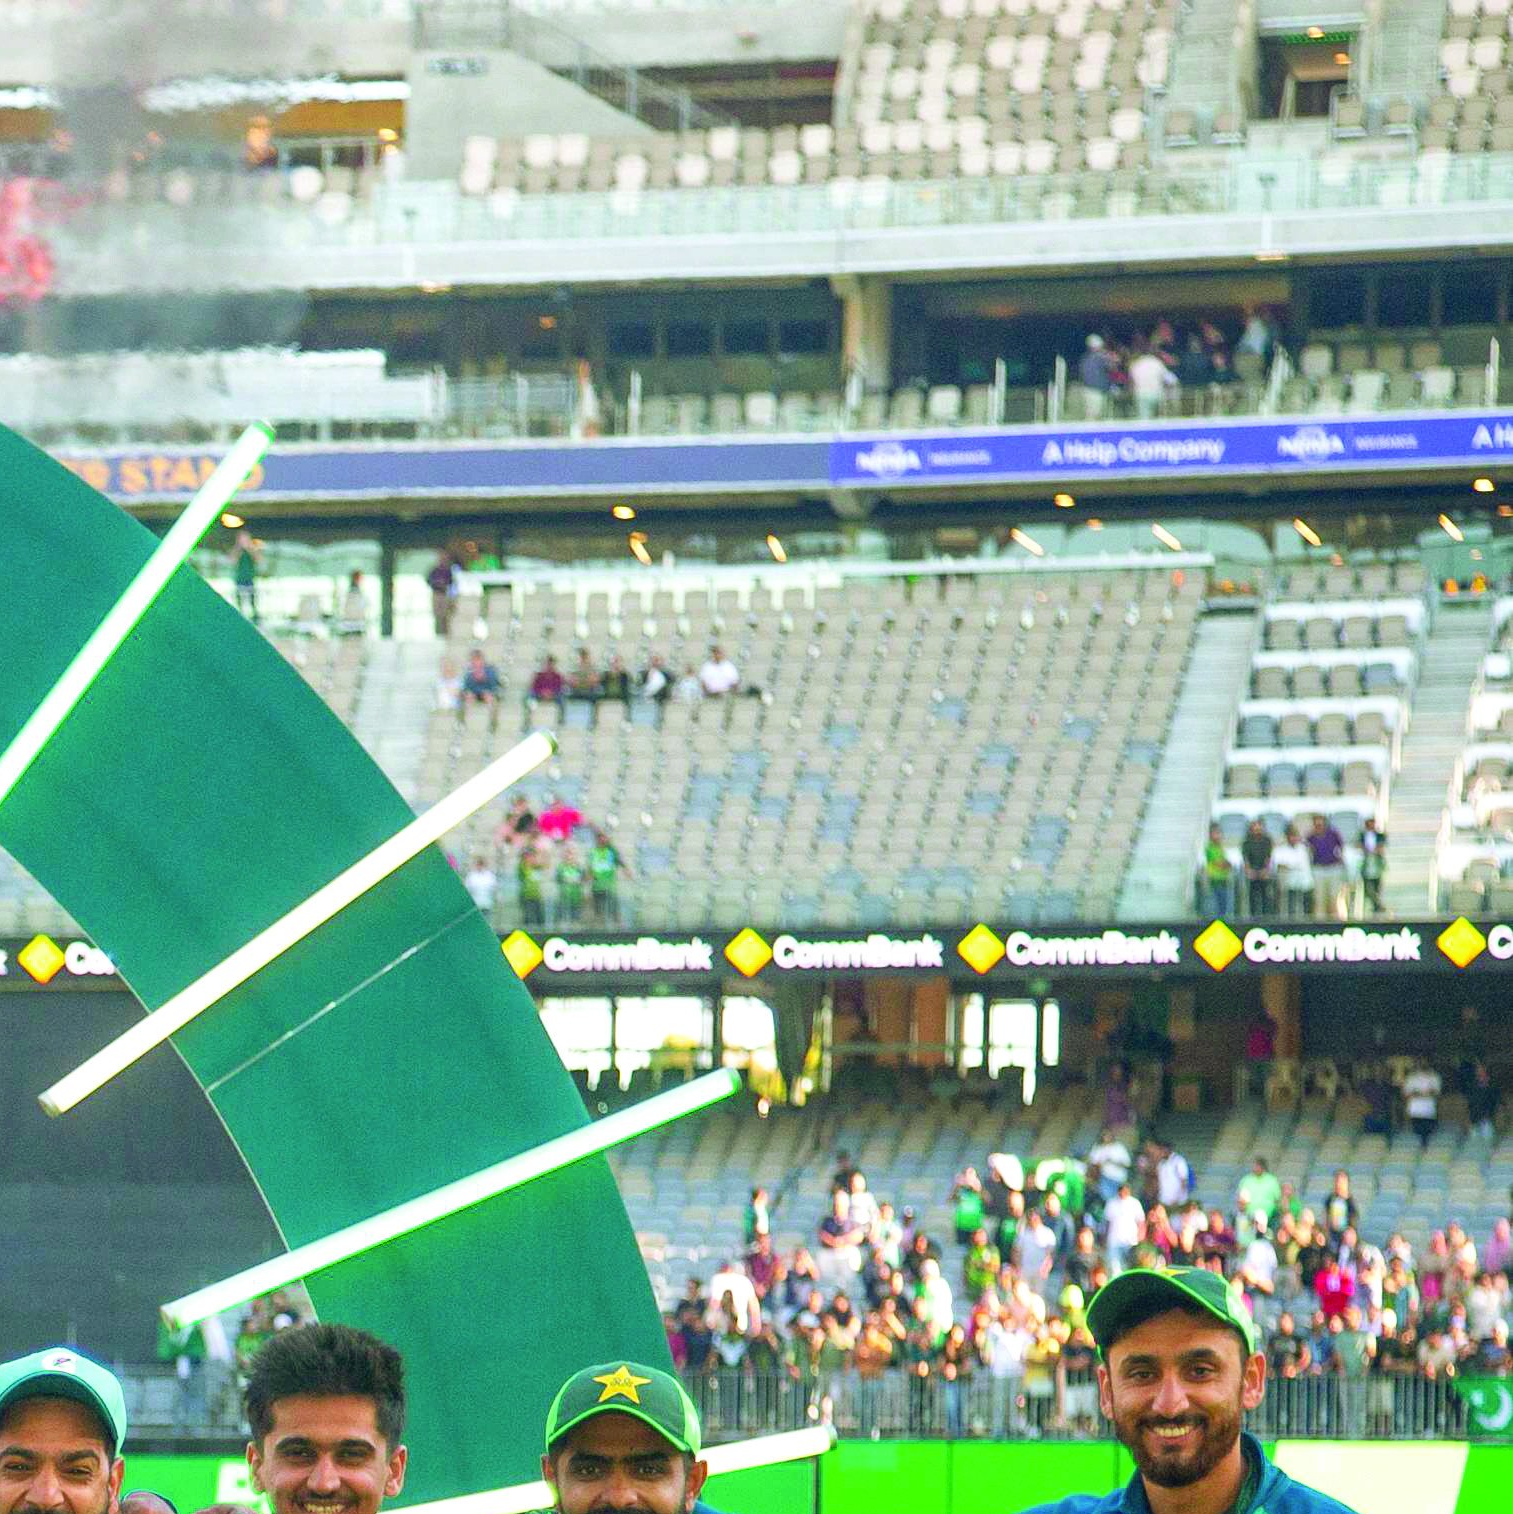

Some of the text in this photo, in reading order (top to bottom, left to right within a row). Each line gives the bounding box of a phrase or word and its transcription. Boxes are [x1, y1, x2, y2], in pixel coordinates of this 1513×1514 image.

[1042, 437, 1225, 467] A Help Company
[773, 934, 943, 968] CommBank
[1005, 930, 1181, 965] CommBank
[1244, 927, 1421, 962] CommBank
